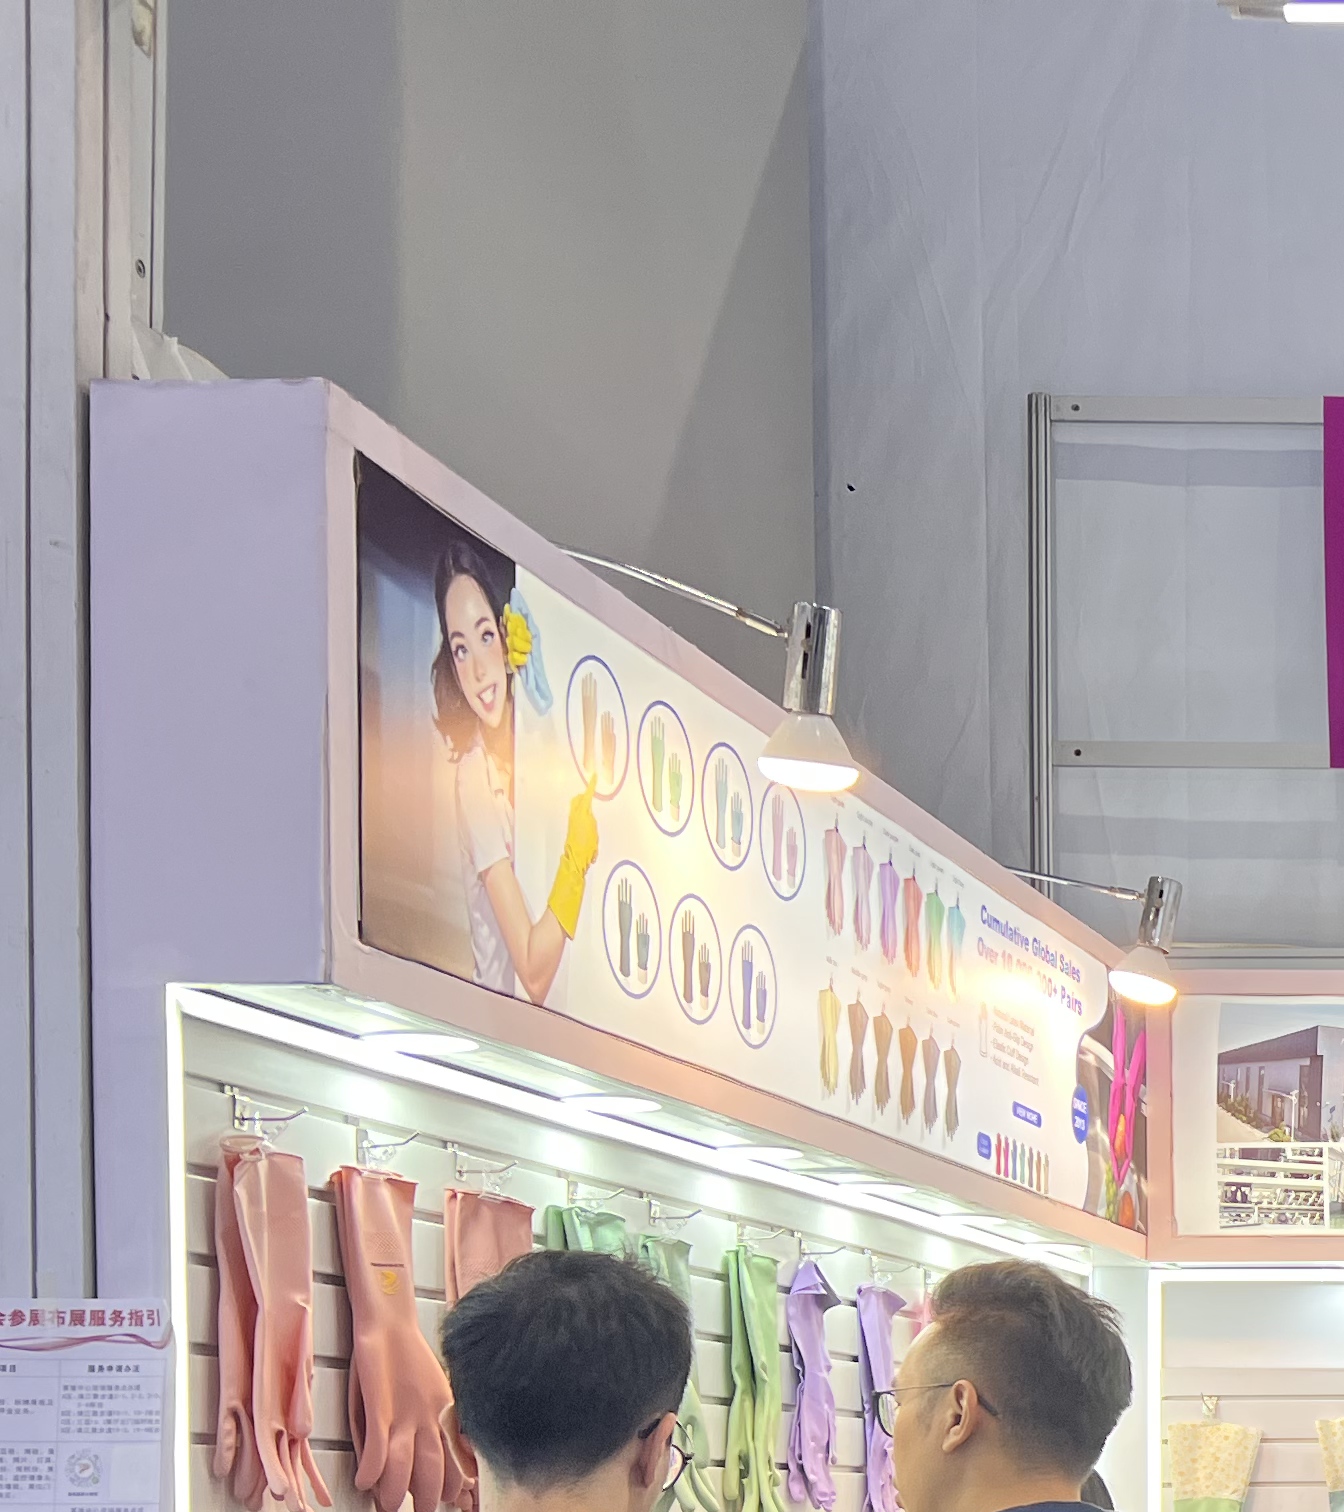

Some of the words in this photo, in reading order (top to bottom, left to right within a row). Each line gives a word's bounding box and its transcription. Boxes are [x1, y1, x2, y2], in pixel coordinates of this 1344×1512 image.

[980, 904, 1030, 952] Cumulative
[1031, 937, 1058, 969] Global
[1059, 952, 1081, 984] Sales
[1060, 984, 1083, 1017] Pairs
